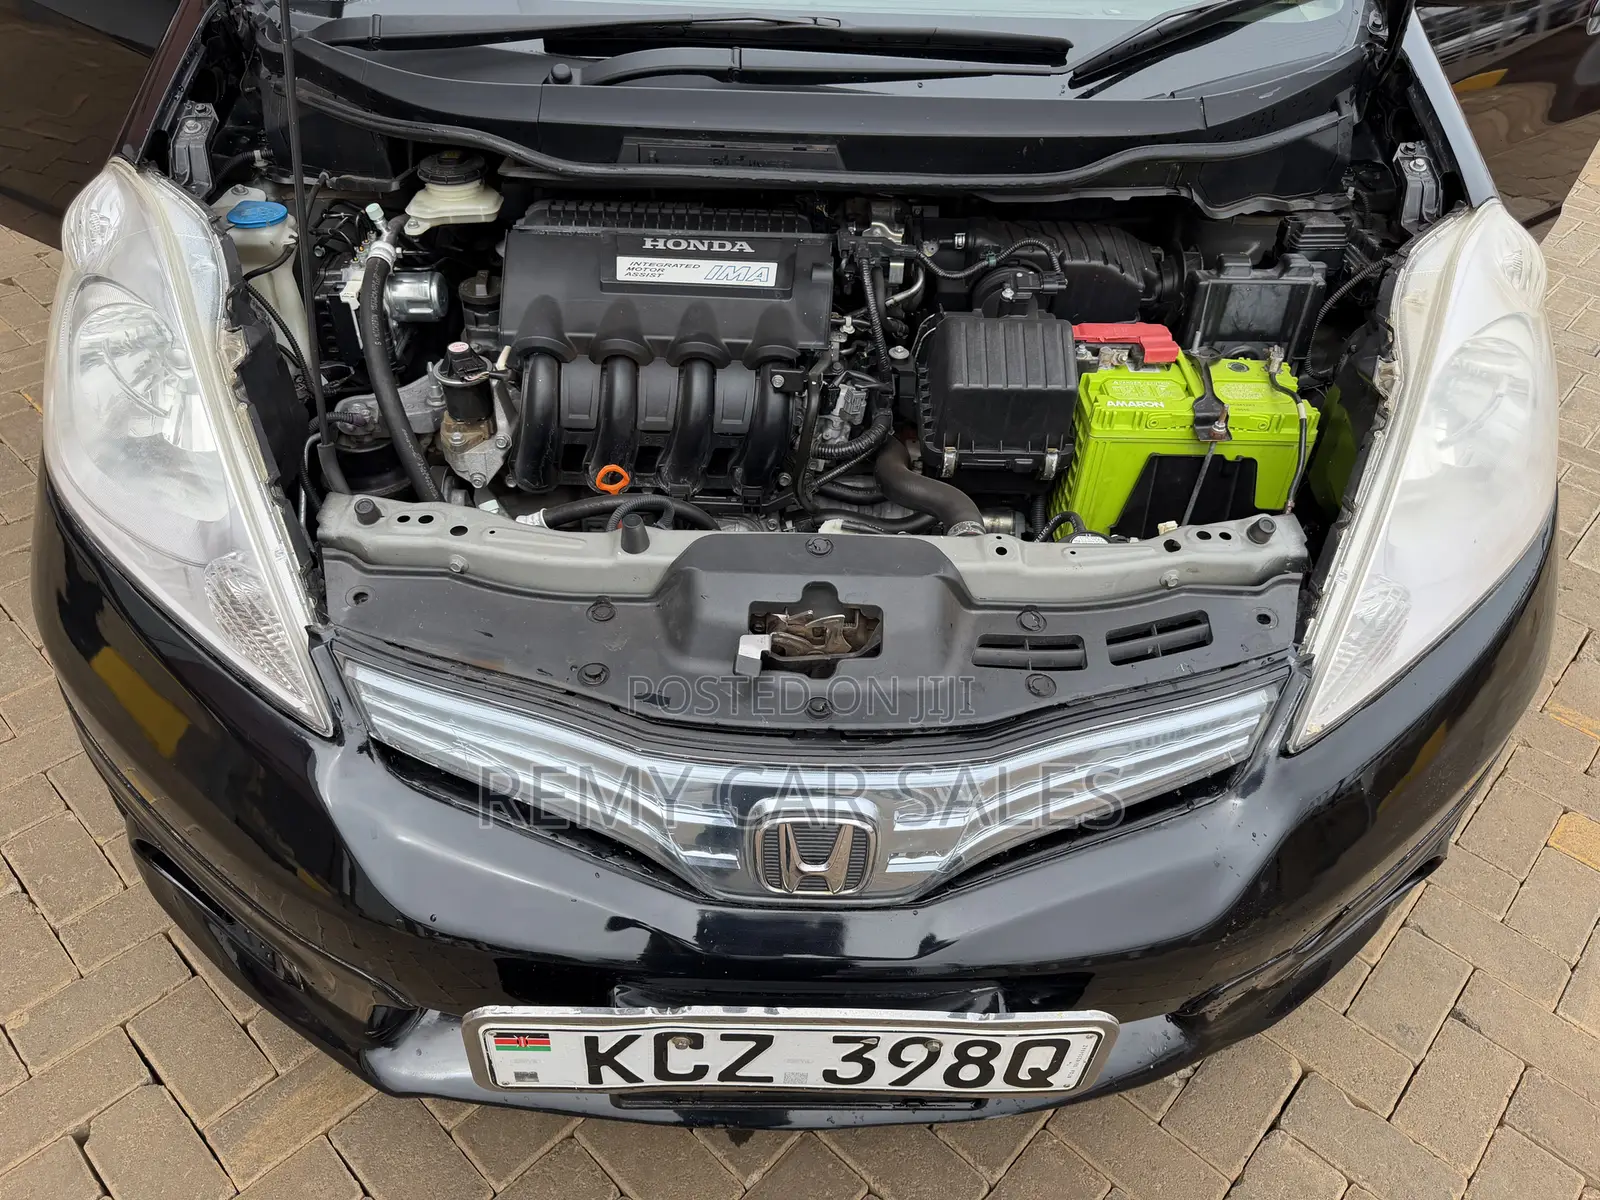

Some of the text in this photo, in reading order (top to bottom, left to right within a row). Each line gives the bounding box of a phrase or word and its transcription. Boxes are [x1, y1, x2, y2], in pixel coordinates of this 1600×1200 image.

[642, 237, 755, 252] HONDA
[629, 261, 700, 269] INTEGRATED
[704, 265, 770, 283] IMA
[1106, 400, 1165, 408] AMARON
[584, 1031, 775, 1085] KCZ
[821, 1035, 1071, 1088] 398Q
